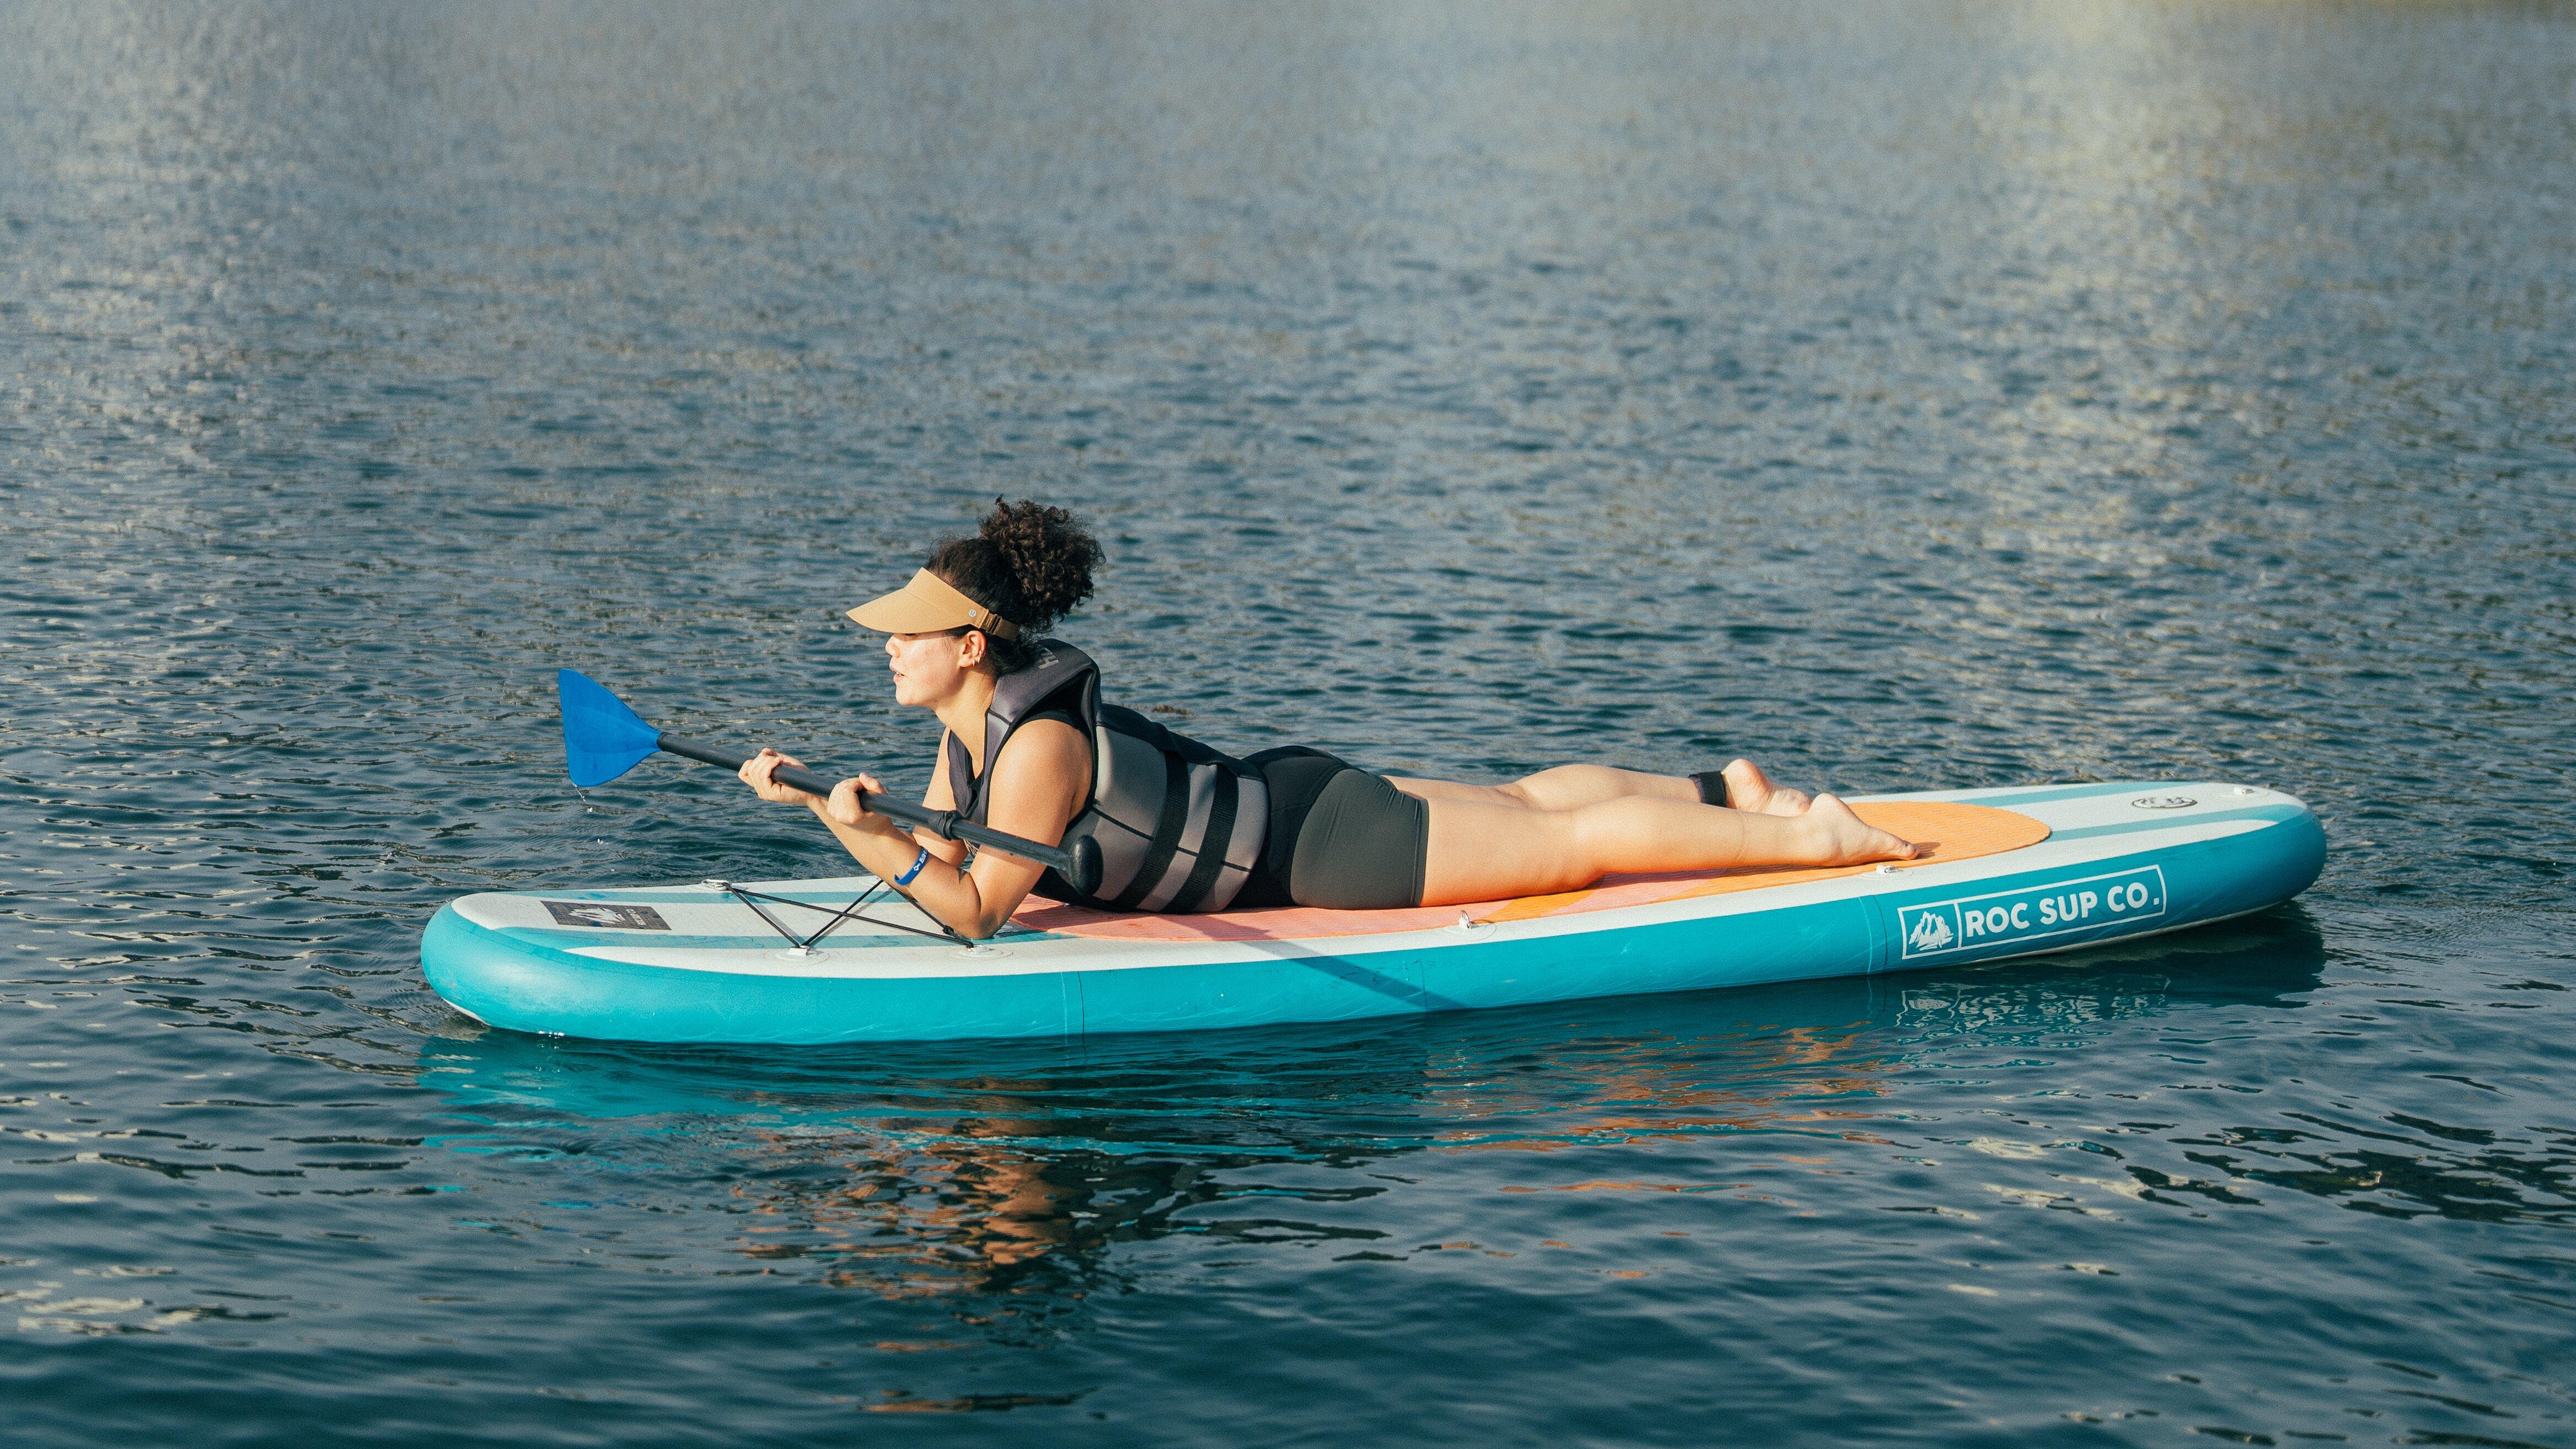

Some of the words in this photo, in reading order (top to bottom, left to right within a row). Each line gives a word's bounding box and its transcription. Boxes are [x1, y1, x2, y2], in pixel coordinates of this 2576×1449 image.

[1965, 903, 2030, 937] ROC
[2039, 891, 2097, 925] SUP
[2107, 882, 2160, 912] CO.
